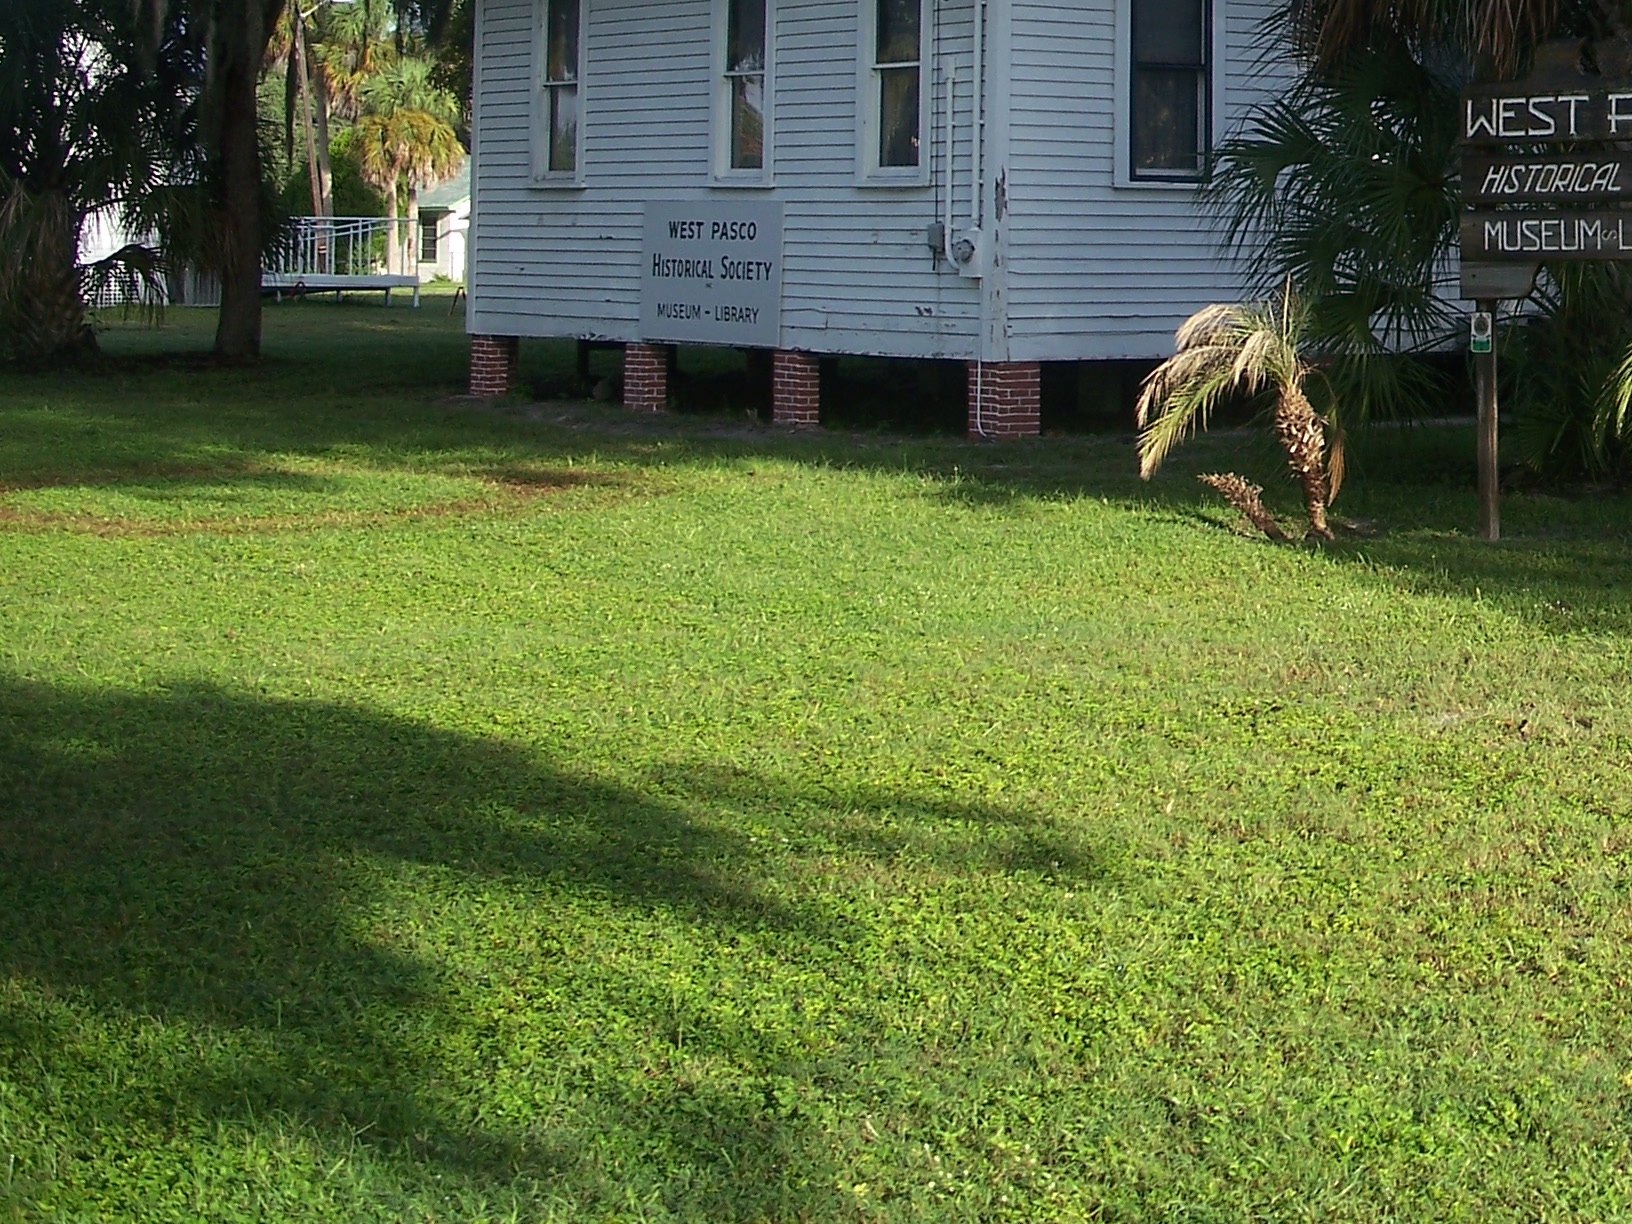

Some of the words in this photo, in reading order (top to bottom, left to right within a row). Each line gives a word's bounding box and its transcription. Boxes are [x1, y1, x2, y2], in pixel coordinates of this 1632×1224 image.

[1466, 94, 1590, 138] WEST
[668, 221, 704, 239] WEST
[711, 222, 757, 240] PASCO
[1484, 219, 1602, 252] MUSEUM
[657, 303, 701, 320] MUSEUM
[715, 306, 760, 324] LIBRARY
